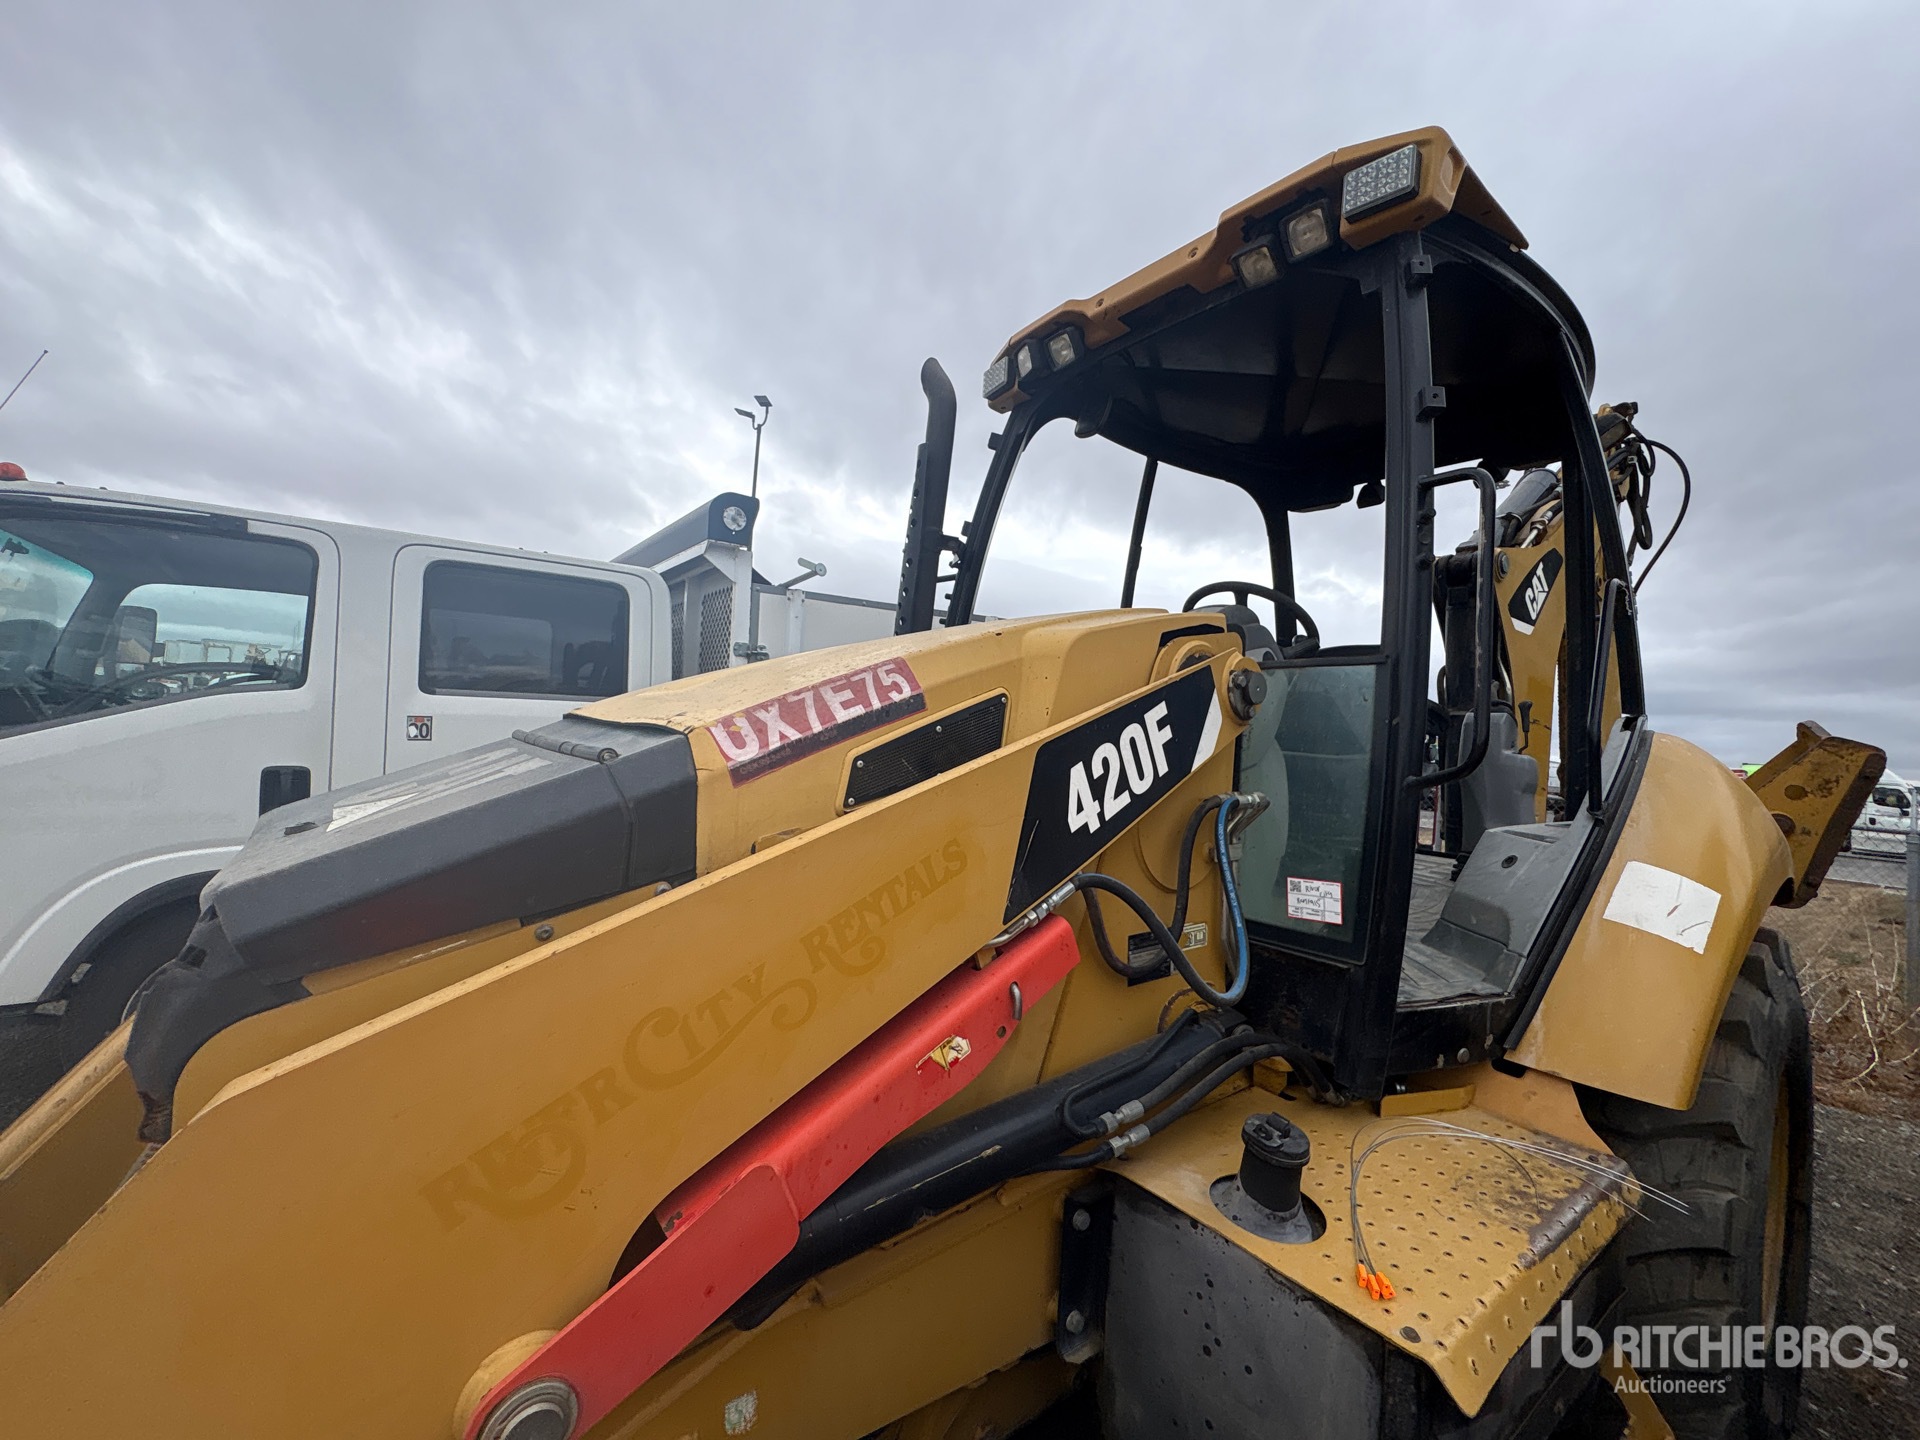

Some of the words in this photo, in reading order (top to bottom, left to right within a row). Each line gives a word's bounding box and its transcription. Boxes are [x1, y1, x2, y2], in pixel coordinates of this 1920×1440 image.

[1525, 561, 1549, 621] CAT
[1067, 700, 1173, 834] 420F
[799, 837, 969, 977] RENTALS
